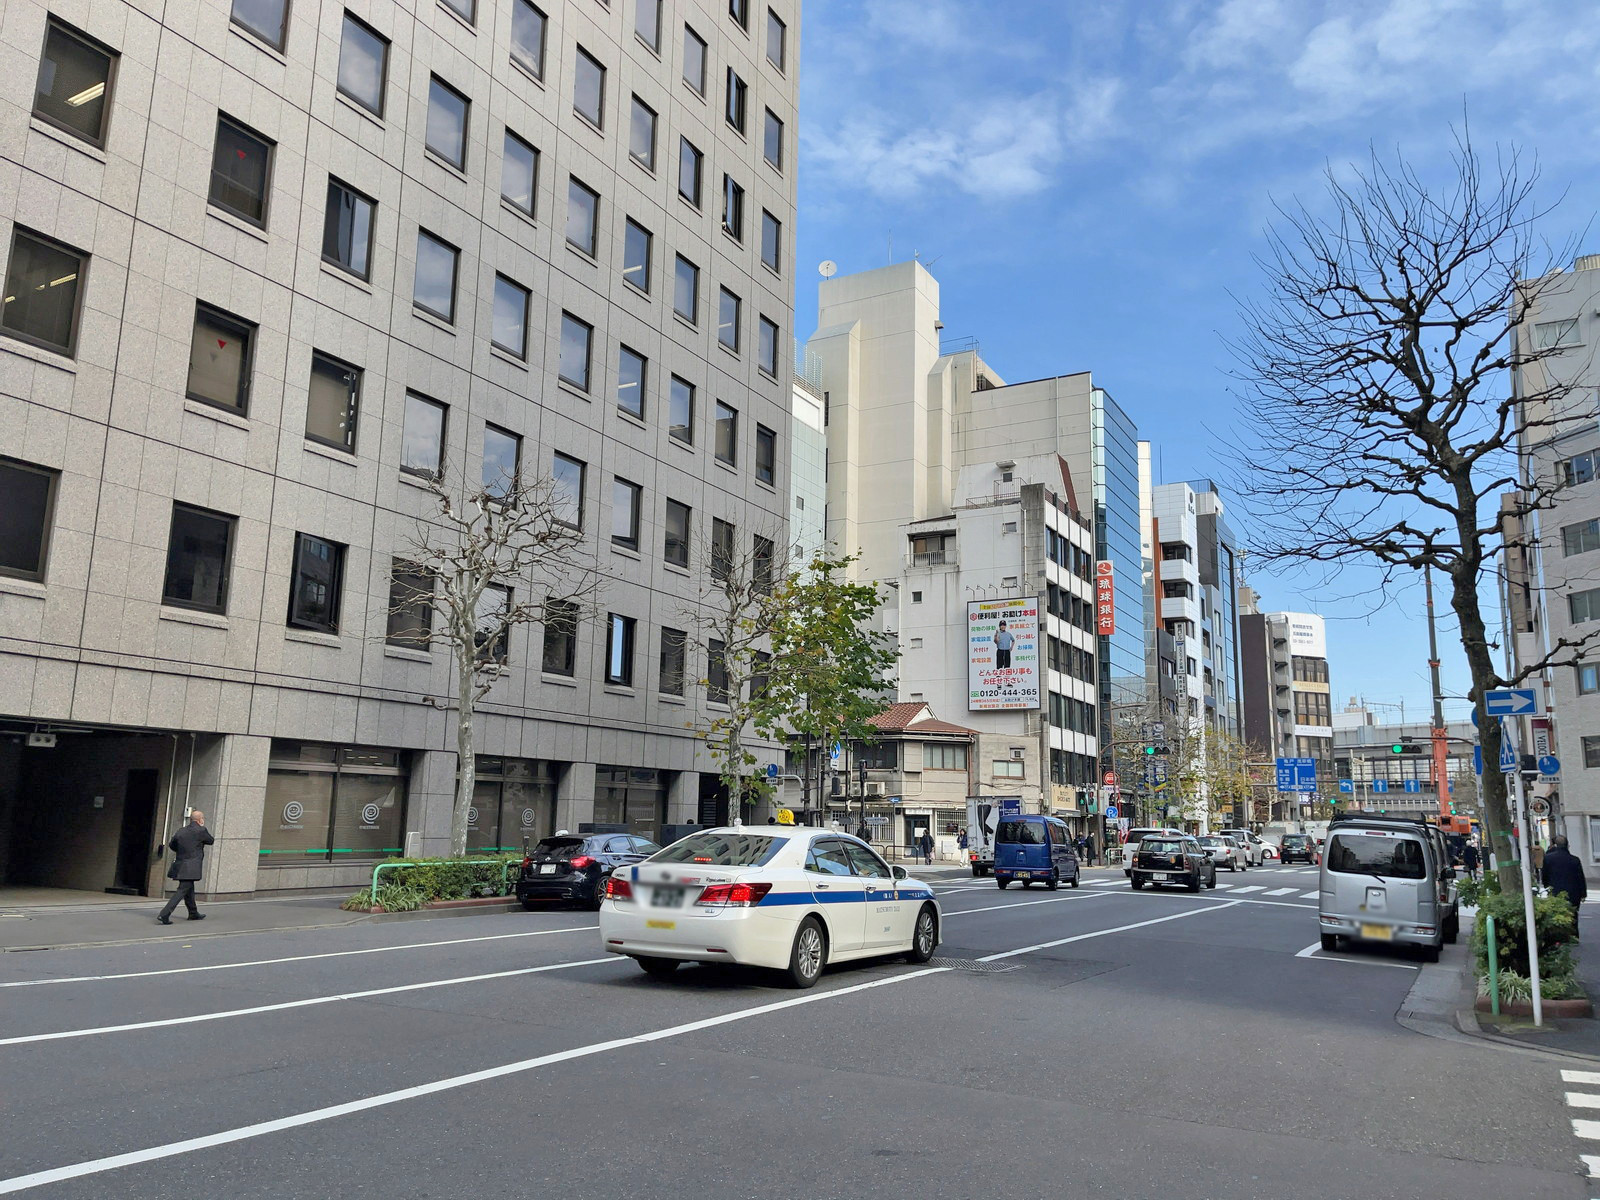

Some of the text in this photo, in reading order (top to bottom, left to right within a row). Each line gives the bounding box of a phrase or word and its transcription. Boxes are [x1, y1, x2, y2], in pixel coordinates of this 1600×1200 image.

[1099, 579, 1112, 628] 琉球銀行
[978, 667, 1032, 677] どんなお困り事も
[1537, 736, 1547, 756] VELOCE
